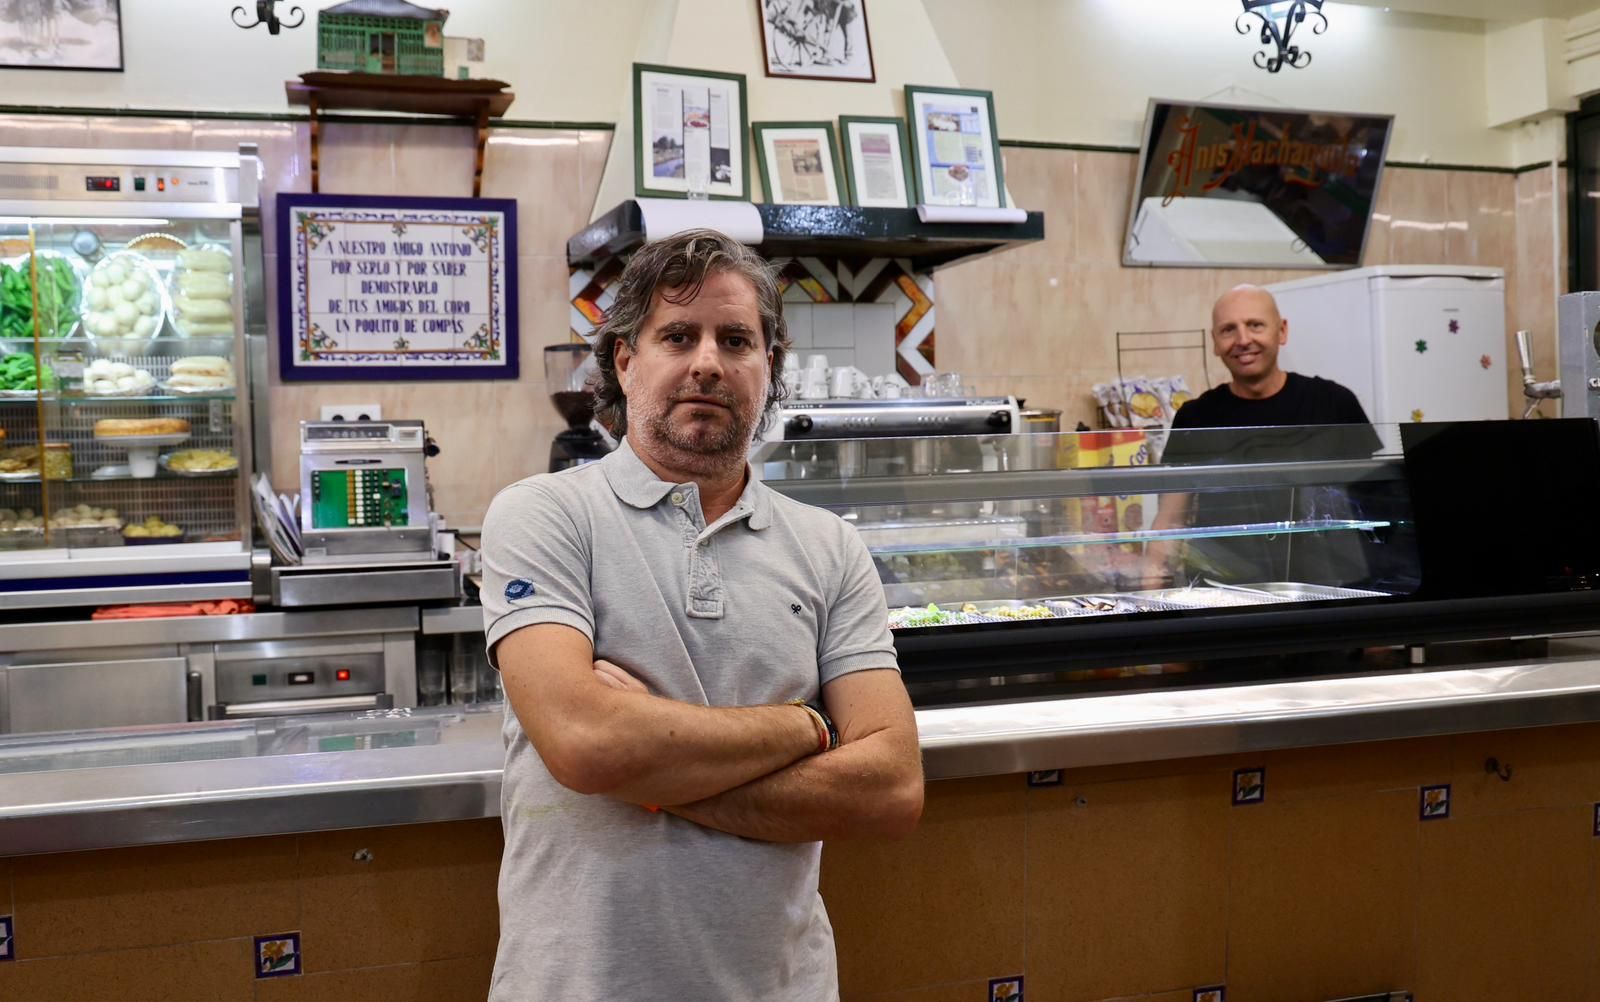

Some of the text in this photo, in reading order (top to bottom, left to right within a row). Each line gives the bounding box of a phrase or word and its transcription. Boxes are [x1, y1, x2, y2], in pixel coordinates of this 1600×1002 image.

[326, 241, 472, 256] A NUESTRO AMIGO ANTONIO
[331, 260, 467, 277] POR SERLO Y POR SABER
[361, 280, 438, 295] DEMOSTRARLO
[328, 299, 471, 315] DE TUS AMIGOS DEL CORO
[336, 318, 351, 333] UN
[355, 319, 399, 334] POQUITO
[404, 319, 418, 333] DE
